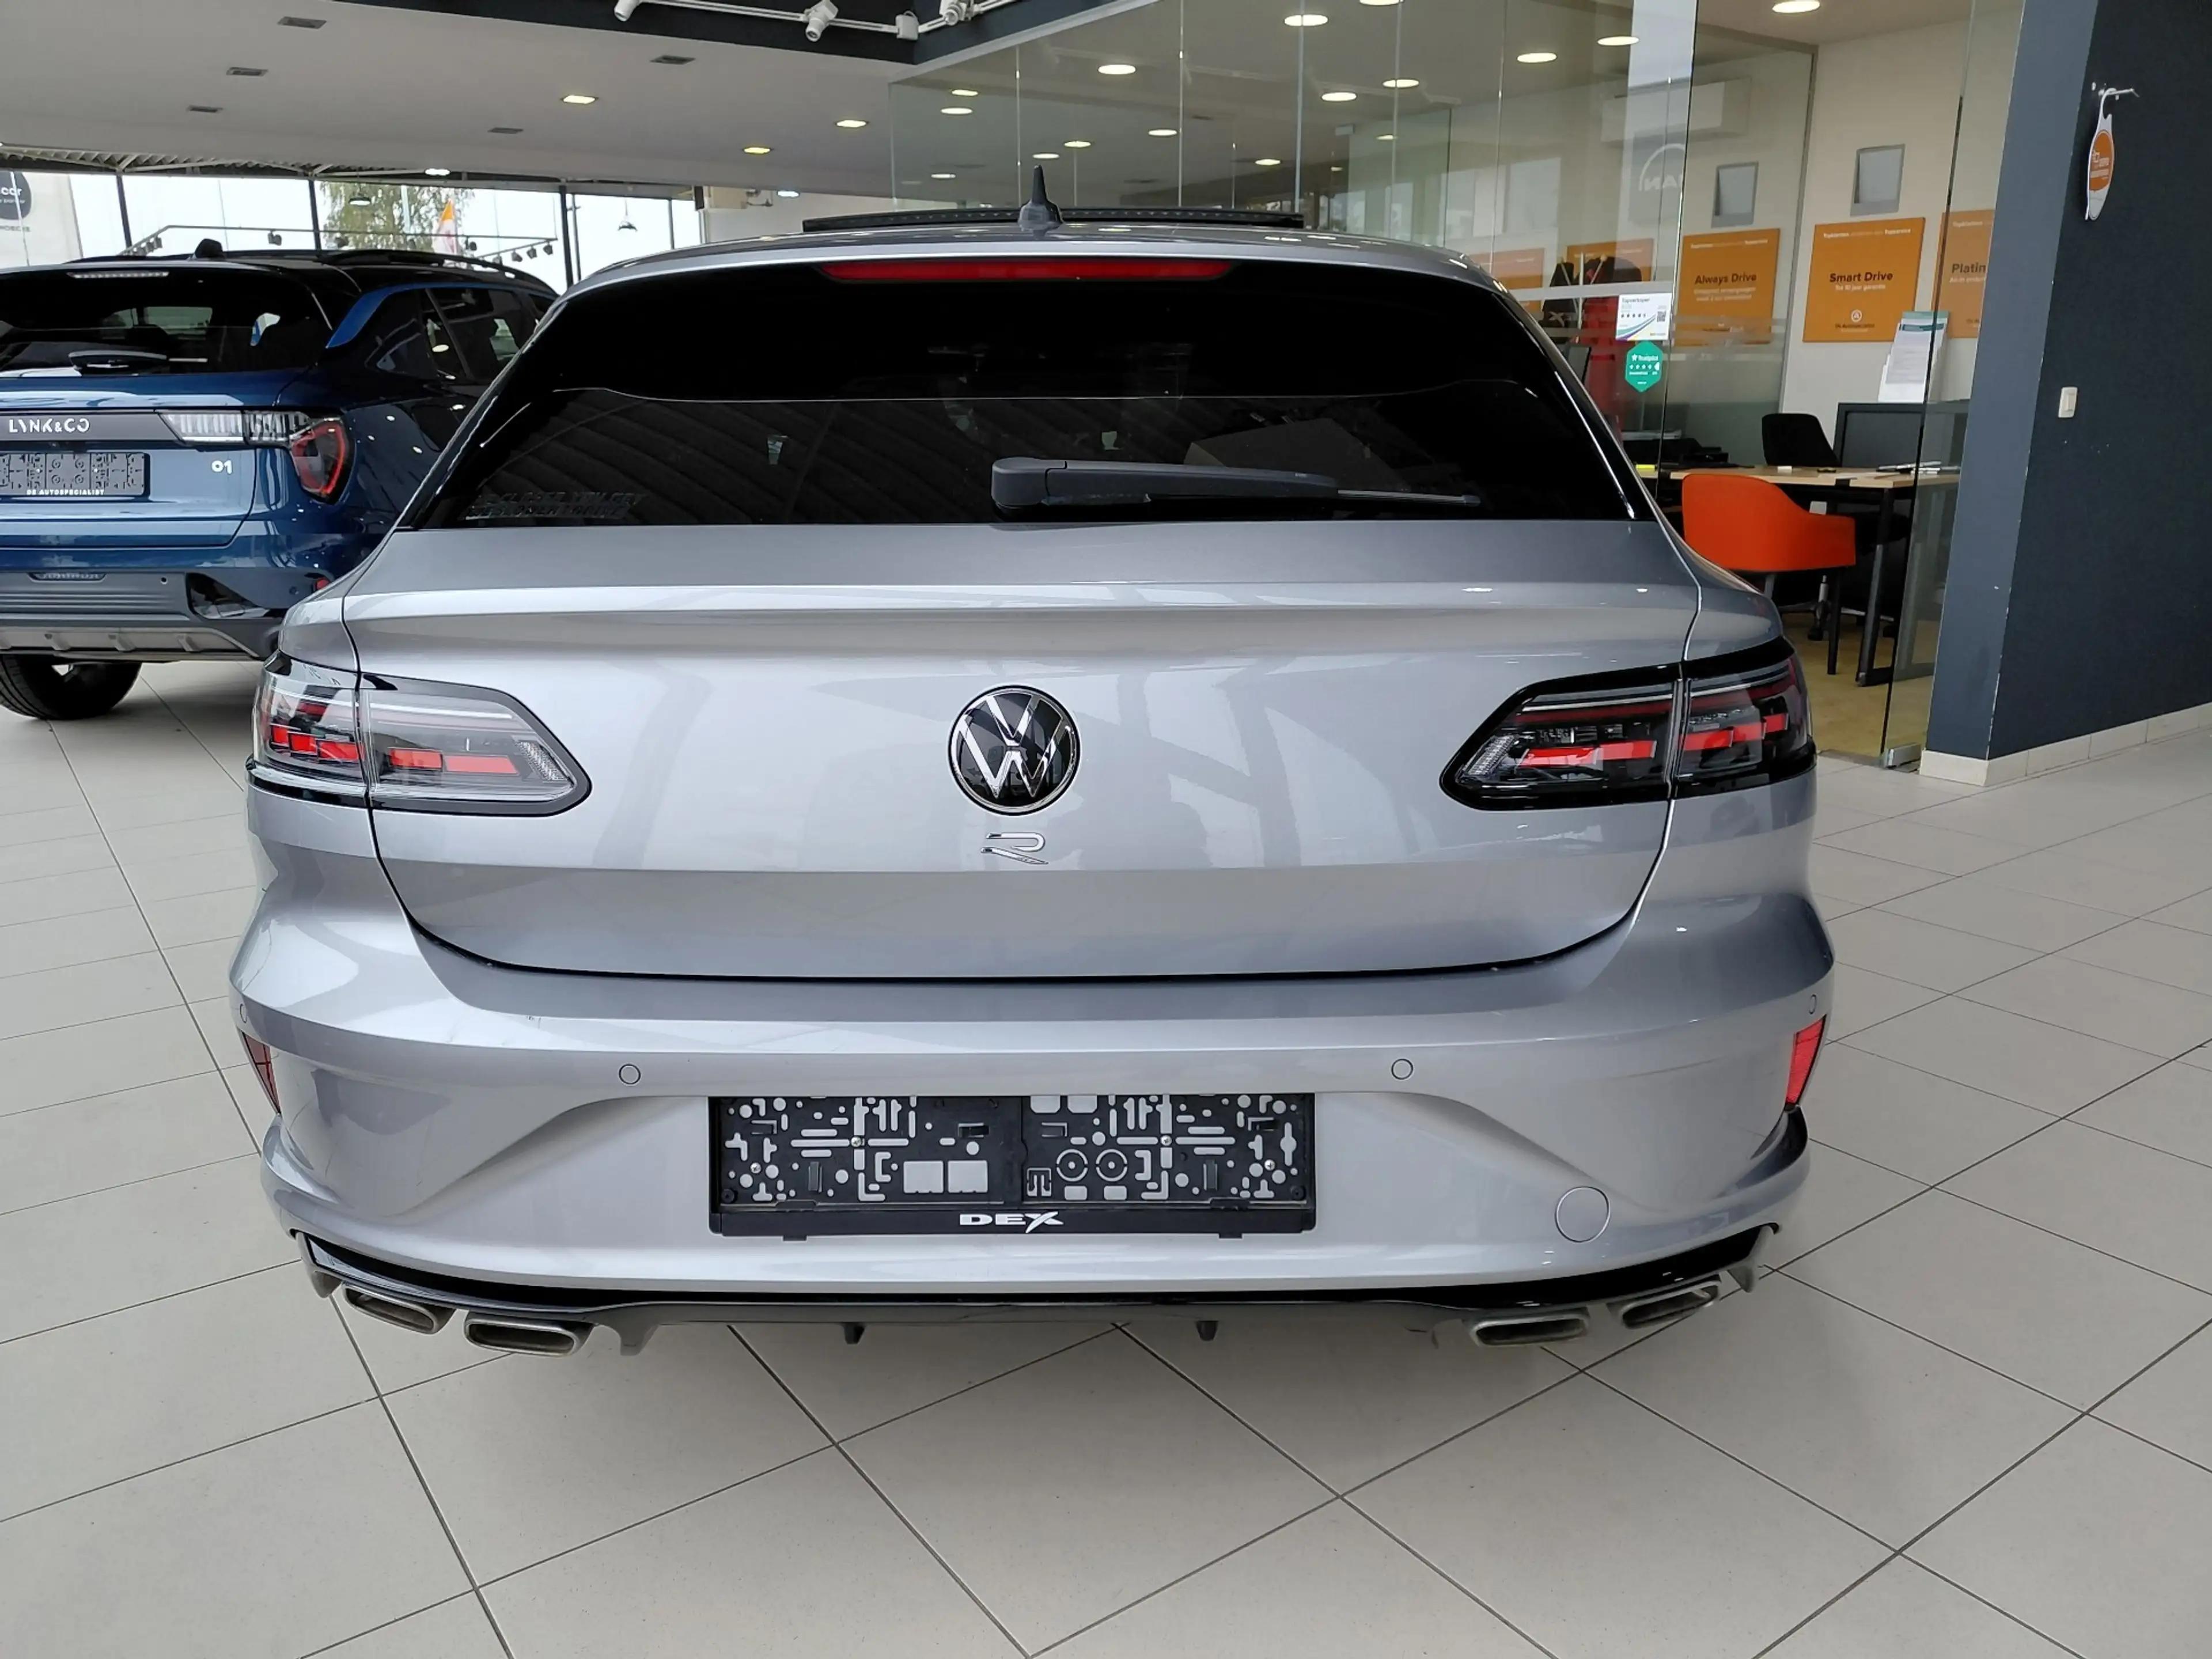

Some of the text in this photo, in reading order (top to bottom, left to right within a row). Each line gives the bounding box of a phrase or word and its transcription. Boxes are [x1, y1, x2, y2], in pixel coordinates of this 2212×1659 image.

[1695, 272, 1757, 286] Always Drive
[1830, 271, 1893, 283] Smart Drive
[9, 418, 90, 433] LYNK&CO
[211, 460, 233, 474] 01
[980, 832, 1049, 865] R
[960, 1211, 1064, 1233] DEX
